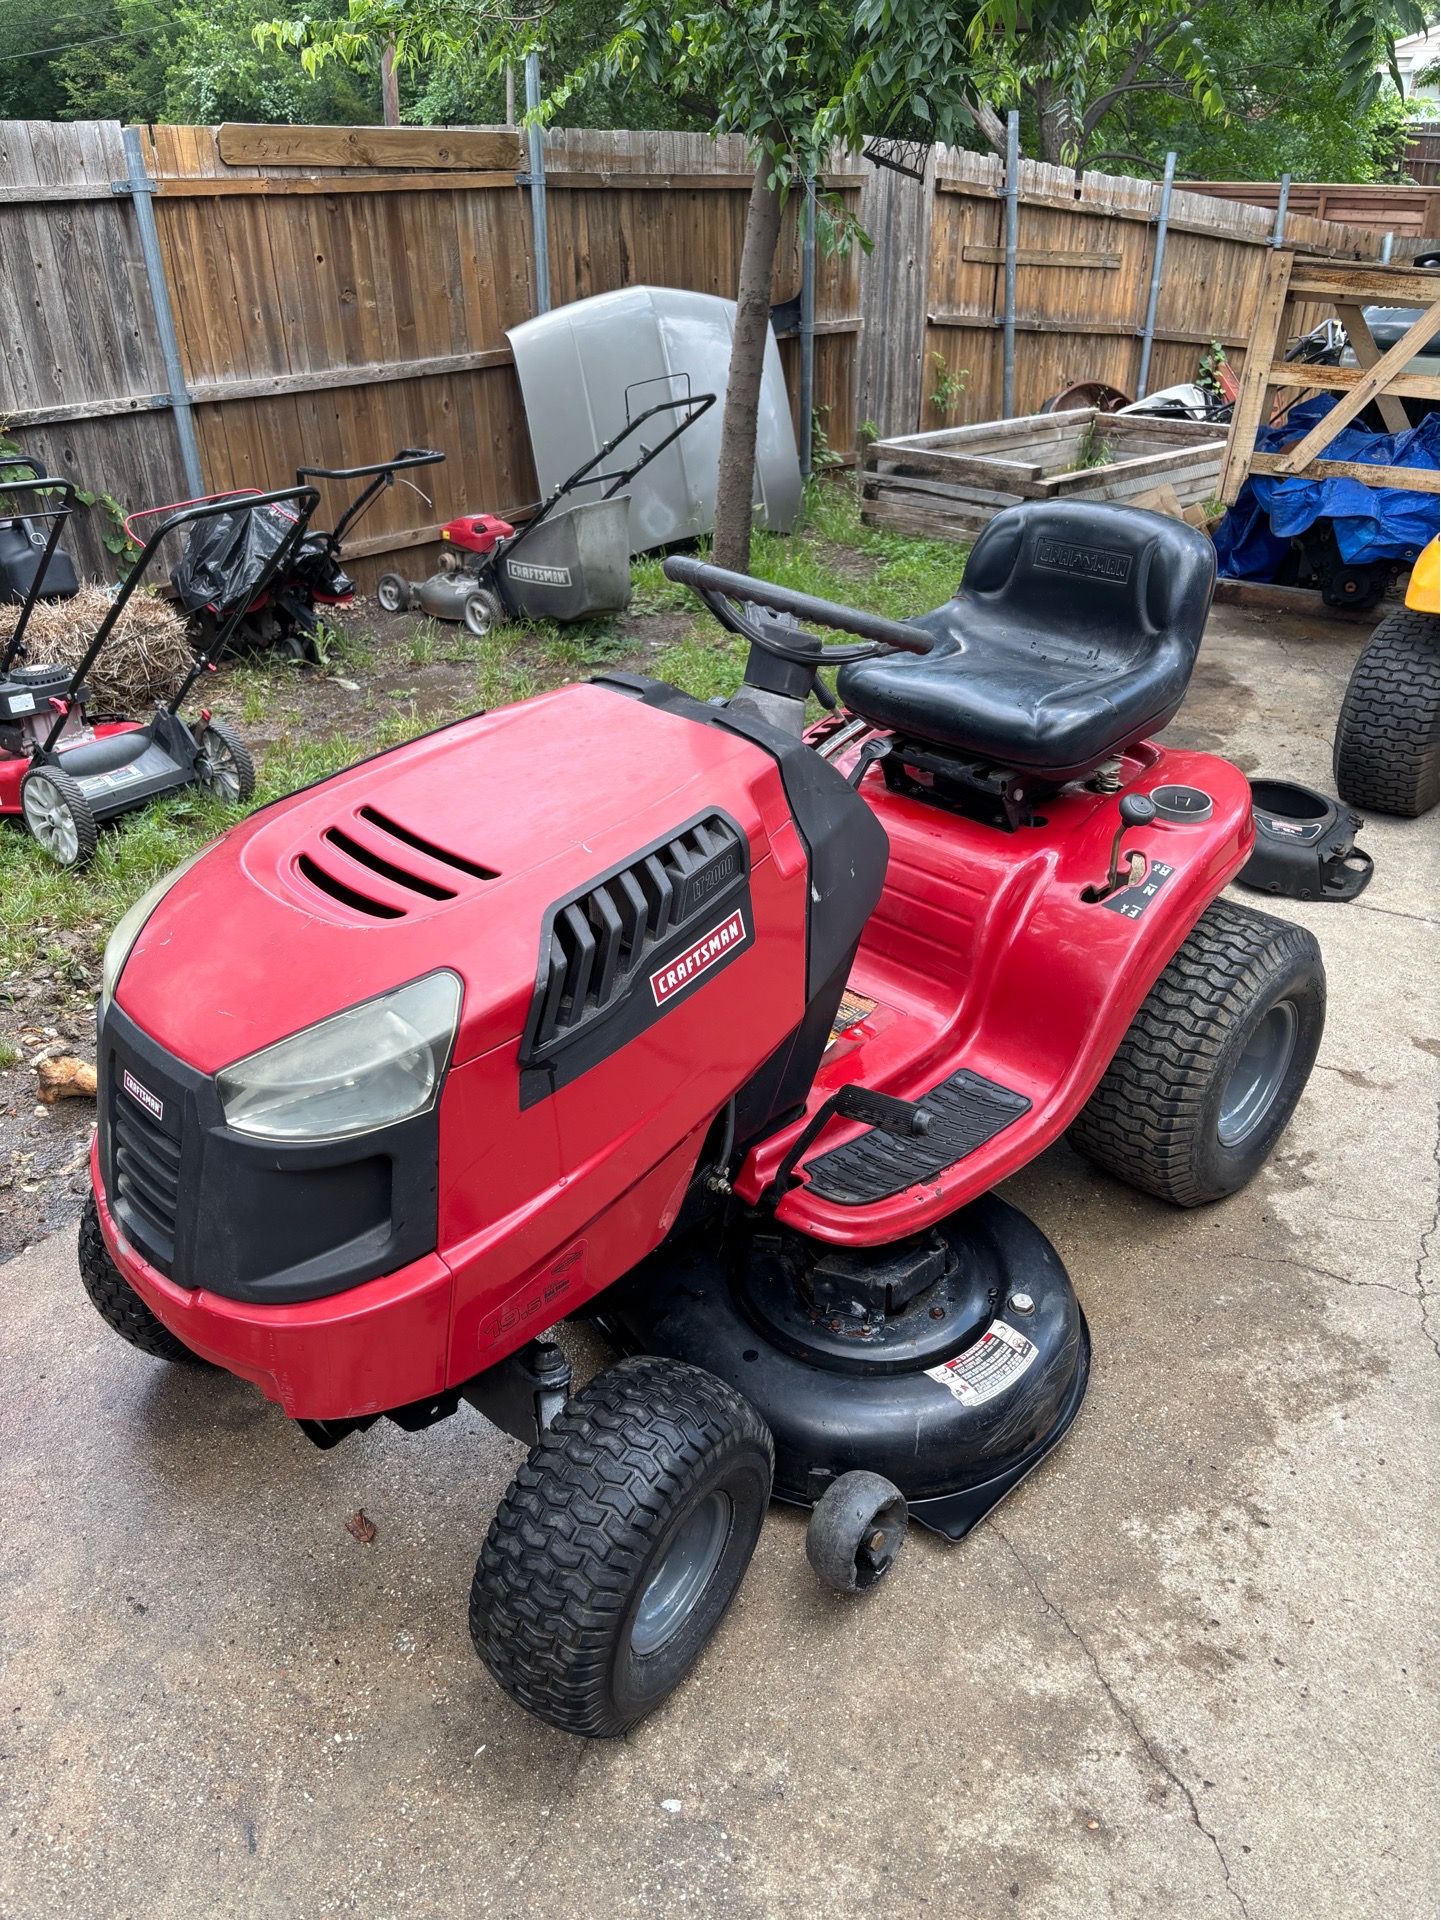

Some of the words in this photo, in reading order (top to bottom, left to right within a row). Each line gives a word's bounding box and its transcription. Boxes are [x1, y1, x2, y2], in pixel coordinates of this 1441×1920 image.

[510, 563, 567, 583] CRAFTSMAN
[658, 920, 739, 993] CRAFTSMAN
[126, 1076, 160, 1113] CRAFTSMAN
